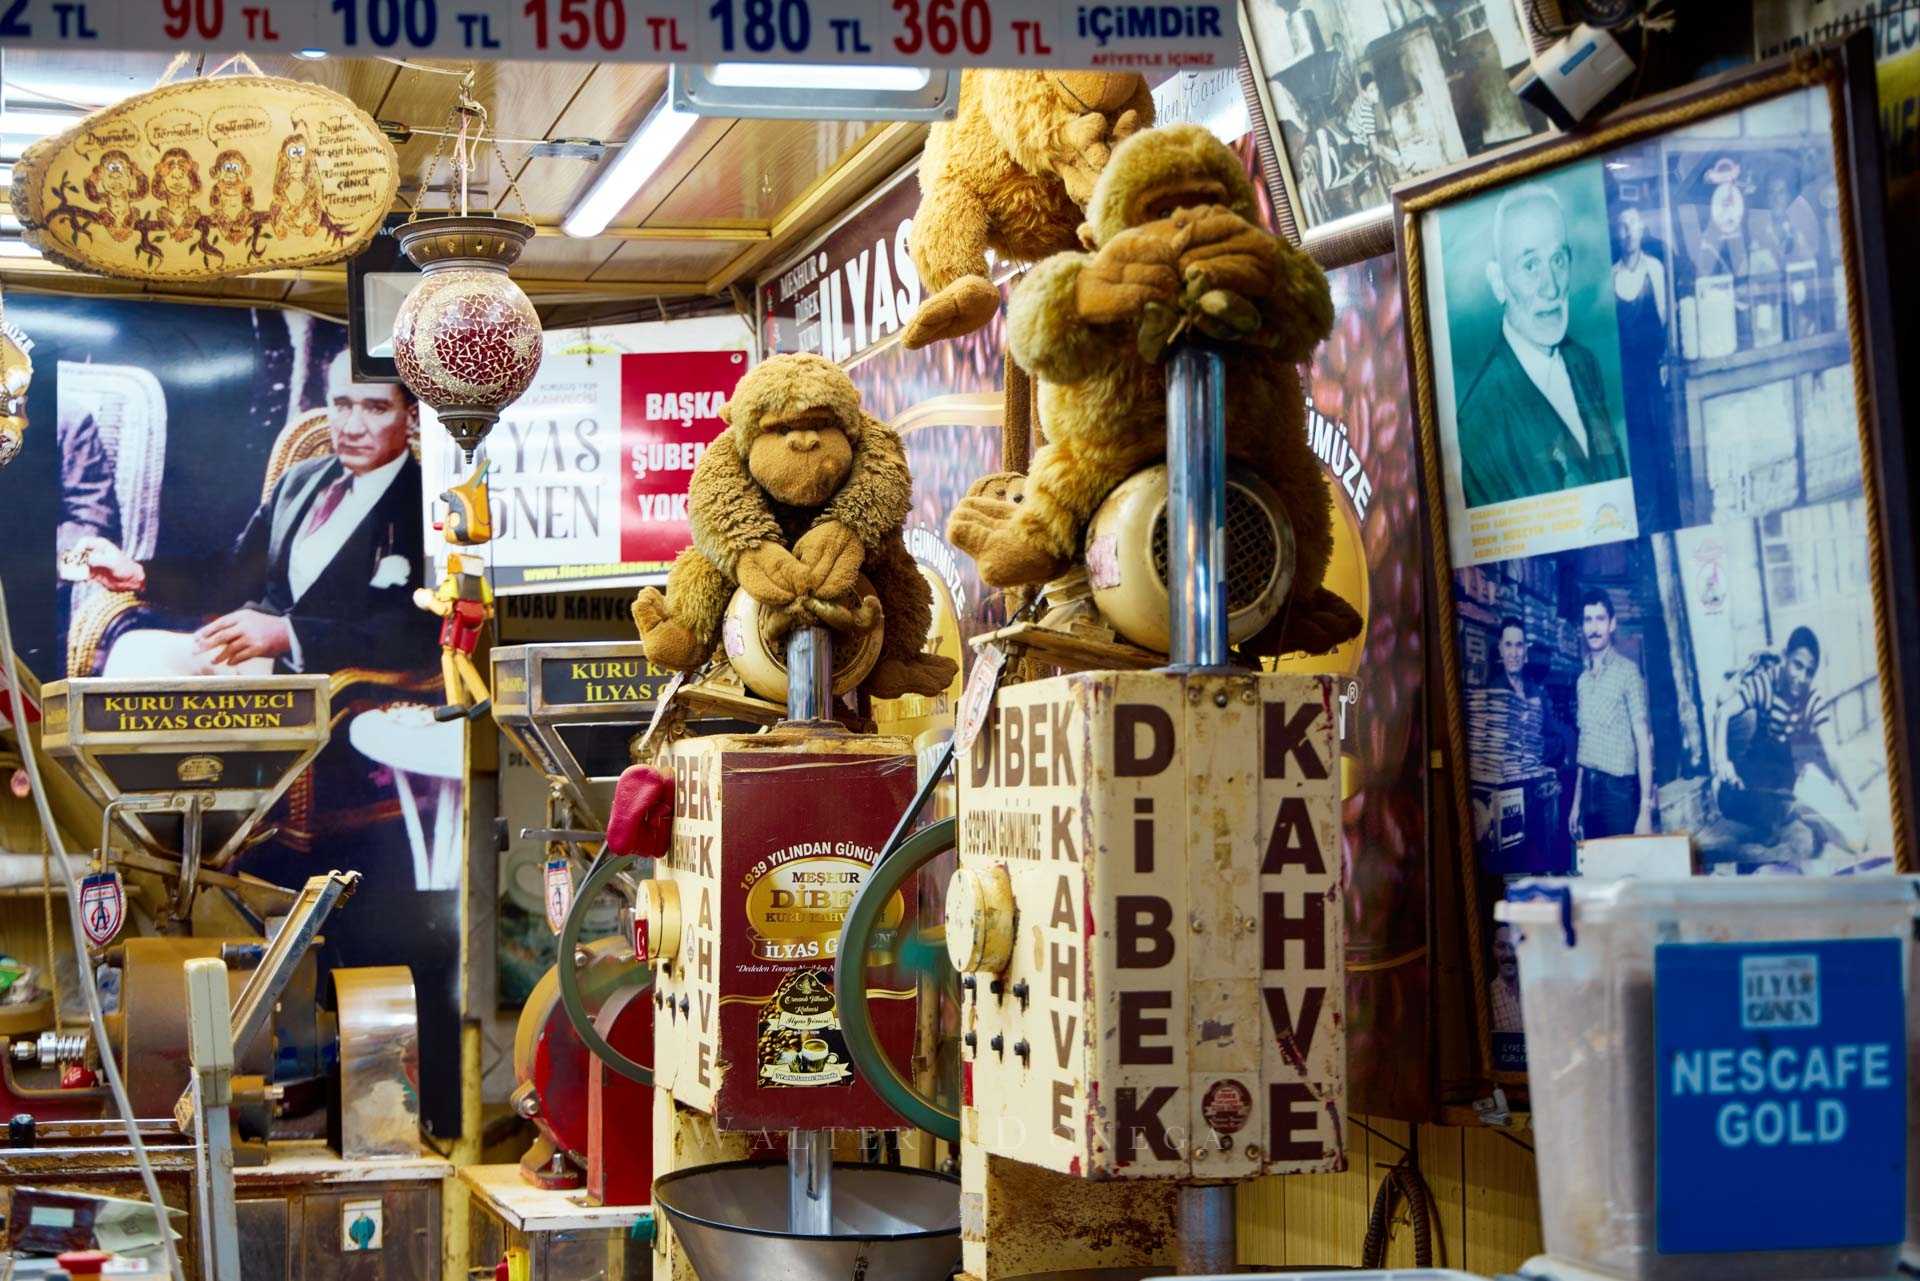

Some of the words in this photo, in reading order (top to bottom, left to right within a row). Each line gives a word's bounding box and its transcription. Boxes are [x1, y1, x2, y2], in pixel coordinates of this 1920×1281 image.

[53, 4, 97, 38] TL
[162, 0, 224, 39] 90
[242, 9, 279, 40] TL
[332, 0, 437, 48] 100
[457, 14, 500, 49] TL
[523, 0, 626, 51] 150
[647, 18, 687, 51] TL
[709, 0, 811, 53] 180
[829, 20, 871, 54] TL
[892, 0, 991, 55] 360
[1011, 22, 1052, 55] TL
[646, 391, 726, 427] BAŞKA
[572, 662, 639, 680] KURU
[585, 682, 651, 702] İLYAS
[104, 696, 174, 712] KURU
[183, 691, 295, 710] KAHVECİ
[119, 713, 189, 731] İLYAS
[194, 711, 282, 730] GÖNEN
[741, 860, 768, 890] 1939
[767, 841, 831, 866] YILINDAN
[765, 941, 820, 959] İLYAS
[1261, 701, 1329, 1162] KAHVE
[699, 835, 715, 1089] KAHVE
[1050, 805, 1079, 1142] KAHVE
[1672, 1045, 1891, 1095] NESCAFE
[1717, 1100, 1848, 1146] GOLD
